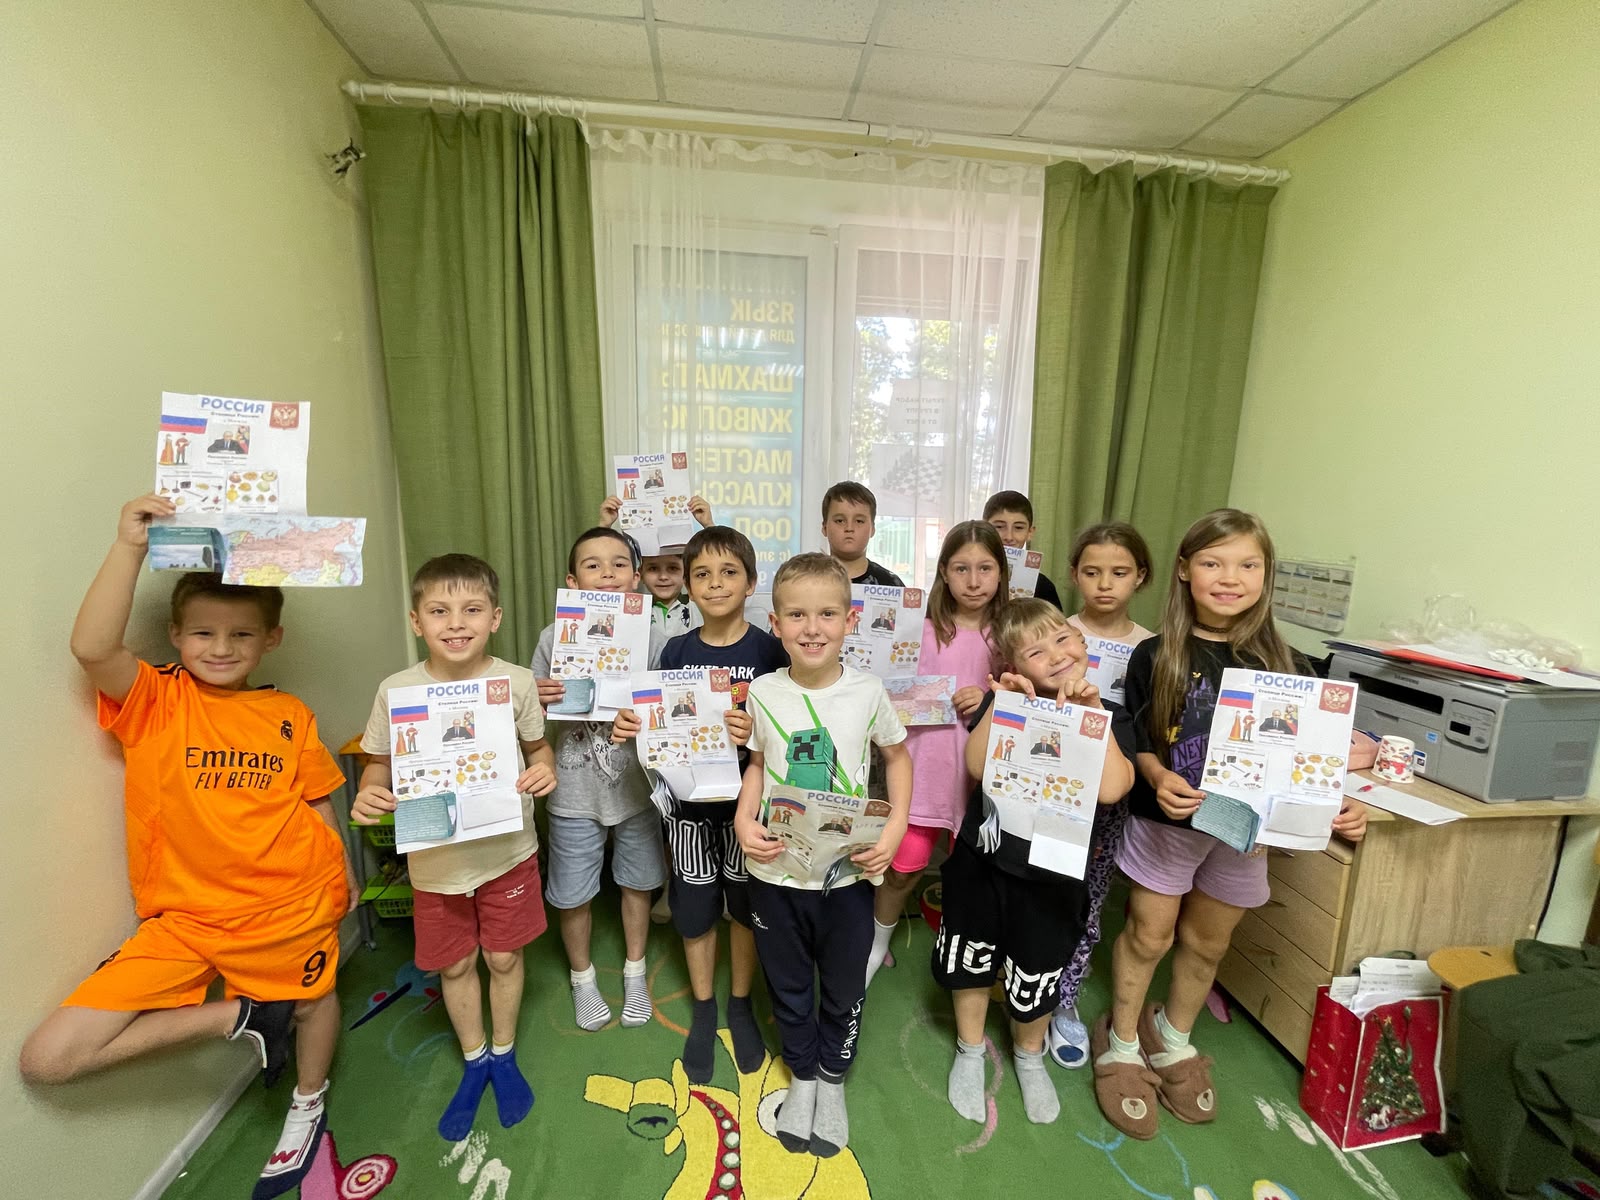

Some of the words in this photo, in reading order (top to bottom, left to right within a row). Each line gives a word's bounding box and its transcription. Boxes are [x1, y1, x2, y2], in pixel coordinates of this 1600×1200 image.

[201, 397, 265, 414] РОССИЯ
[633, 454, 665, 463] РОССИЯ
[580, 592, 621, 603] РОССИЯ
[864, 586, 901, 597] РОССИЯ
[661, 671, 704, 680] РОССИЯ
[722, 665, 755, 680] ARK
[427, 683, 479, 697] РОССИЯ
[1254, 673, 1314, 692] РОССИЯ
[186, 746, 284, 773] Emirates
[194, 772, 223, 789] FLY
[226, 771, 272, 790] BETTER
[807, 792, 860, 808] РОССИЯ
[301, 950, 327, 988] 9
